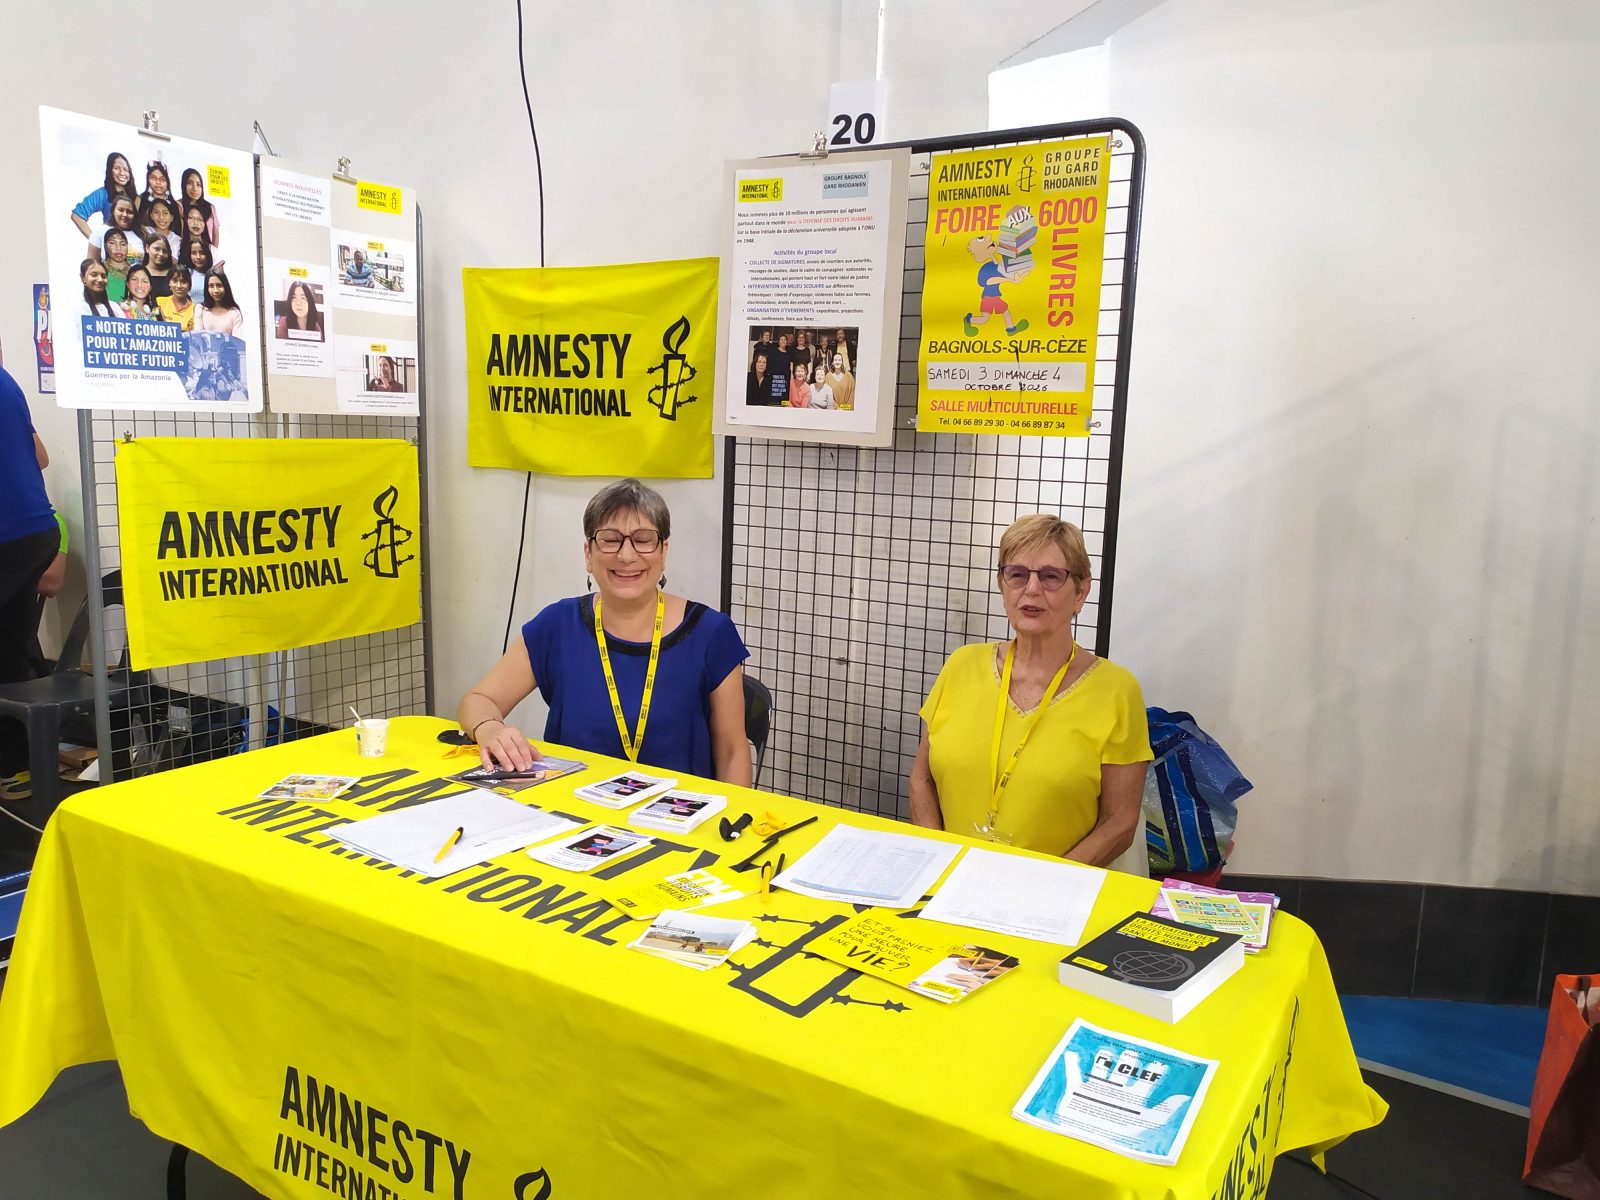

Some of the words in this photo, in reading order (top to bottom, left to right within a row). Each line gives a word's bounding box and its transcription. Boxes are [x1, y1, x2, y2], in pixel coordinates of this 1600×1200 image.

[830, 113, 876, 146] 20
[1045, 148, 1101, 163] GROUPE
[938, 157, 1013, 183] AMNESTY
[1044, 165, 1060, 176] DU
[1065, 161, 1099, 173] GARD
[741, 184, 769, 193] AMNESTY
[1043, 175, 1098, 190] RHODANIEN
[360, 188, 387, 201] AMNESTY
[360, 197, 387, 208] INTERNATIONAL
[937, 184, 1011, 202] INTERNATIONAL
[934, 203, 1002, 235] FOIRE
[1007, 206, 1034, 229] AUX
[1038, 196, 1098, 227] 6000
[1047, 227, 1079, 327] LIVRES
[95, 320, 132, 335] NOTRE
[135, 323, 178, 338] COMBAT
[86, 335, 118, 350] POUR
[121, 337, 186, 355] L'AMAZONIE,
[928, 335, 1088, 354] BAGNOLS-SUR-CÈZE
[87, 351, 101, 364] ET
[103, 352, 139, 366] VOTRE
[141, 354, 176, 368] FUTUR
[486, 333, 632, 379] AMNESTY
[84, 371, 117, 379] Guerreras
[140, 373, 171, 381] Amazonia
[927, 367, 970, 381] SAMEDI
[978, 366, 988, 380] 3
[994, 369, 1048, 381] DIMANCHE
[1052, 366, 1061, 381] 4
[964, 383, 1012, 391] OCTOBRE
[488, 385, 632, 417] INTERNATIONAL
[930, 400, 964, 412] SALLE
[967, 400, 1078, 415] MULTICULTURELLE
[952, 418, 962, 426] 04
[963, 418, 972, 426] 66
[973, 418, 983, 427] 89
[984, 419, 994, 427] 29
[995, 419, 1005, 427] 30
[1010, 420, 1020, 428] 04
[1021, 420, 1031, 428] 66
[1032, 420, 1042, 428] 89
[1043, 421, 1054, 429] 87
[1055, 421, 1065, 429] 34
[157, 504, 343, 560] AMNESTY
[159, 557, 349, 601] INTERNATIONAL
[216, 799, 633, 947] INTEIONAL
[863, 918, 883, 926] ET
[1150, 922, 1194, 938] SITUATION
[1196, 934, 1217, 942] DES
[828, 936, 851, 948] UNE
[848, 927, 871, 939] UNE
[872, 937, 908, 952] HEURE
[857, 922, 885, 936] VOUS
[887, 934, 935, 954] PRENIEZ
[1122, 928, 1146, 938] DANS
[1160, 939, 1194, 950] MONDE
[1129, 923, 1161, 935] DROITS
[1163, 933, 1207, 946] HUMAINS
[838, 931, 864, 945] POUR
[867, 943, 911, 961] SAUVER
[1117, 1063, 1162, 1082] CLEF
[280, 1065, 471, 1200] AMNESTY
[274, 1132, 406, 1200] INTERNA
